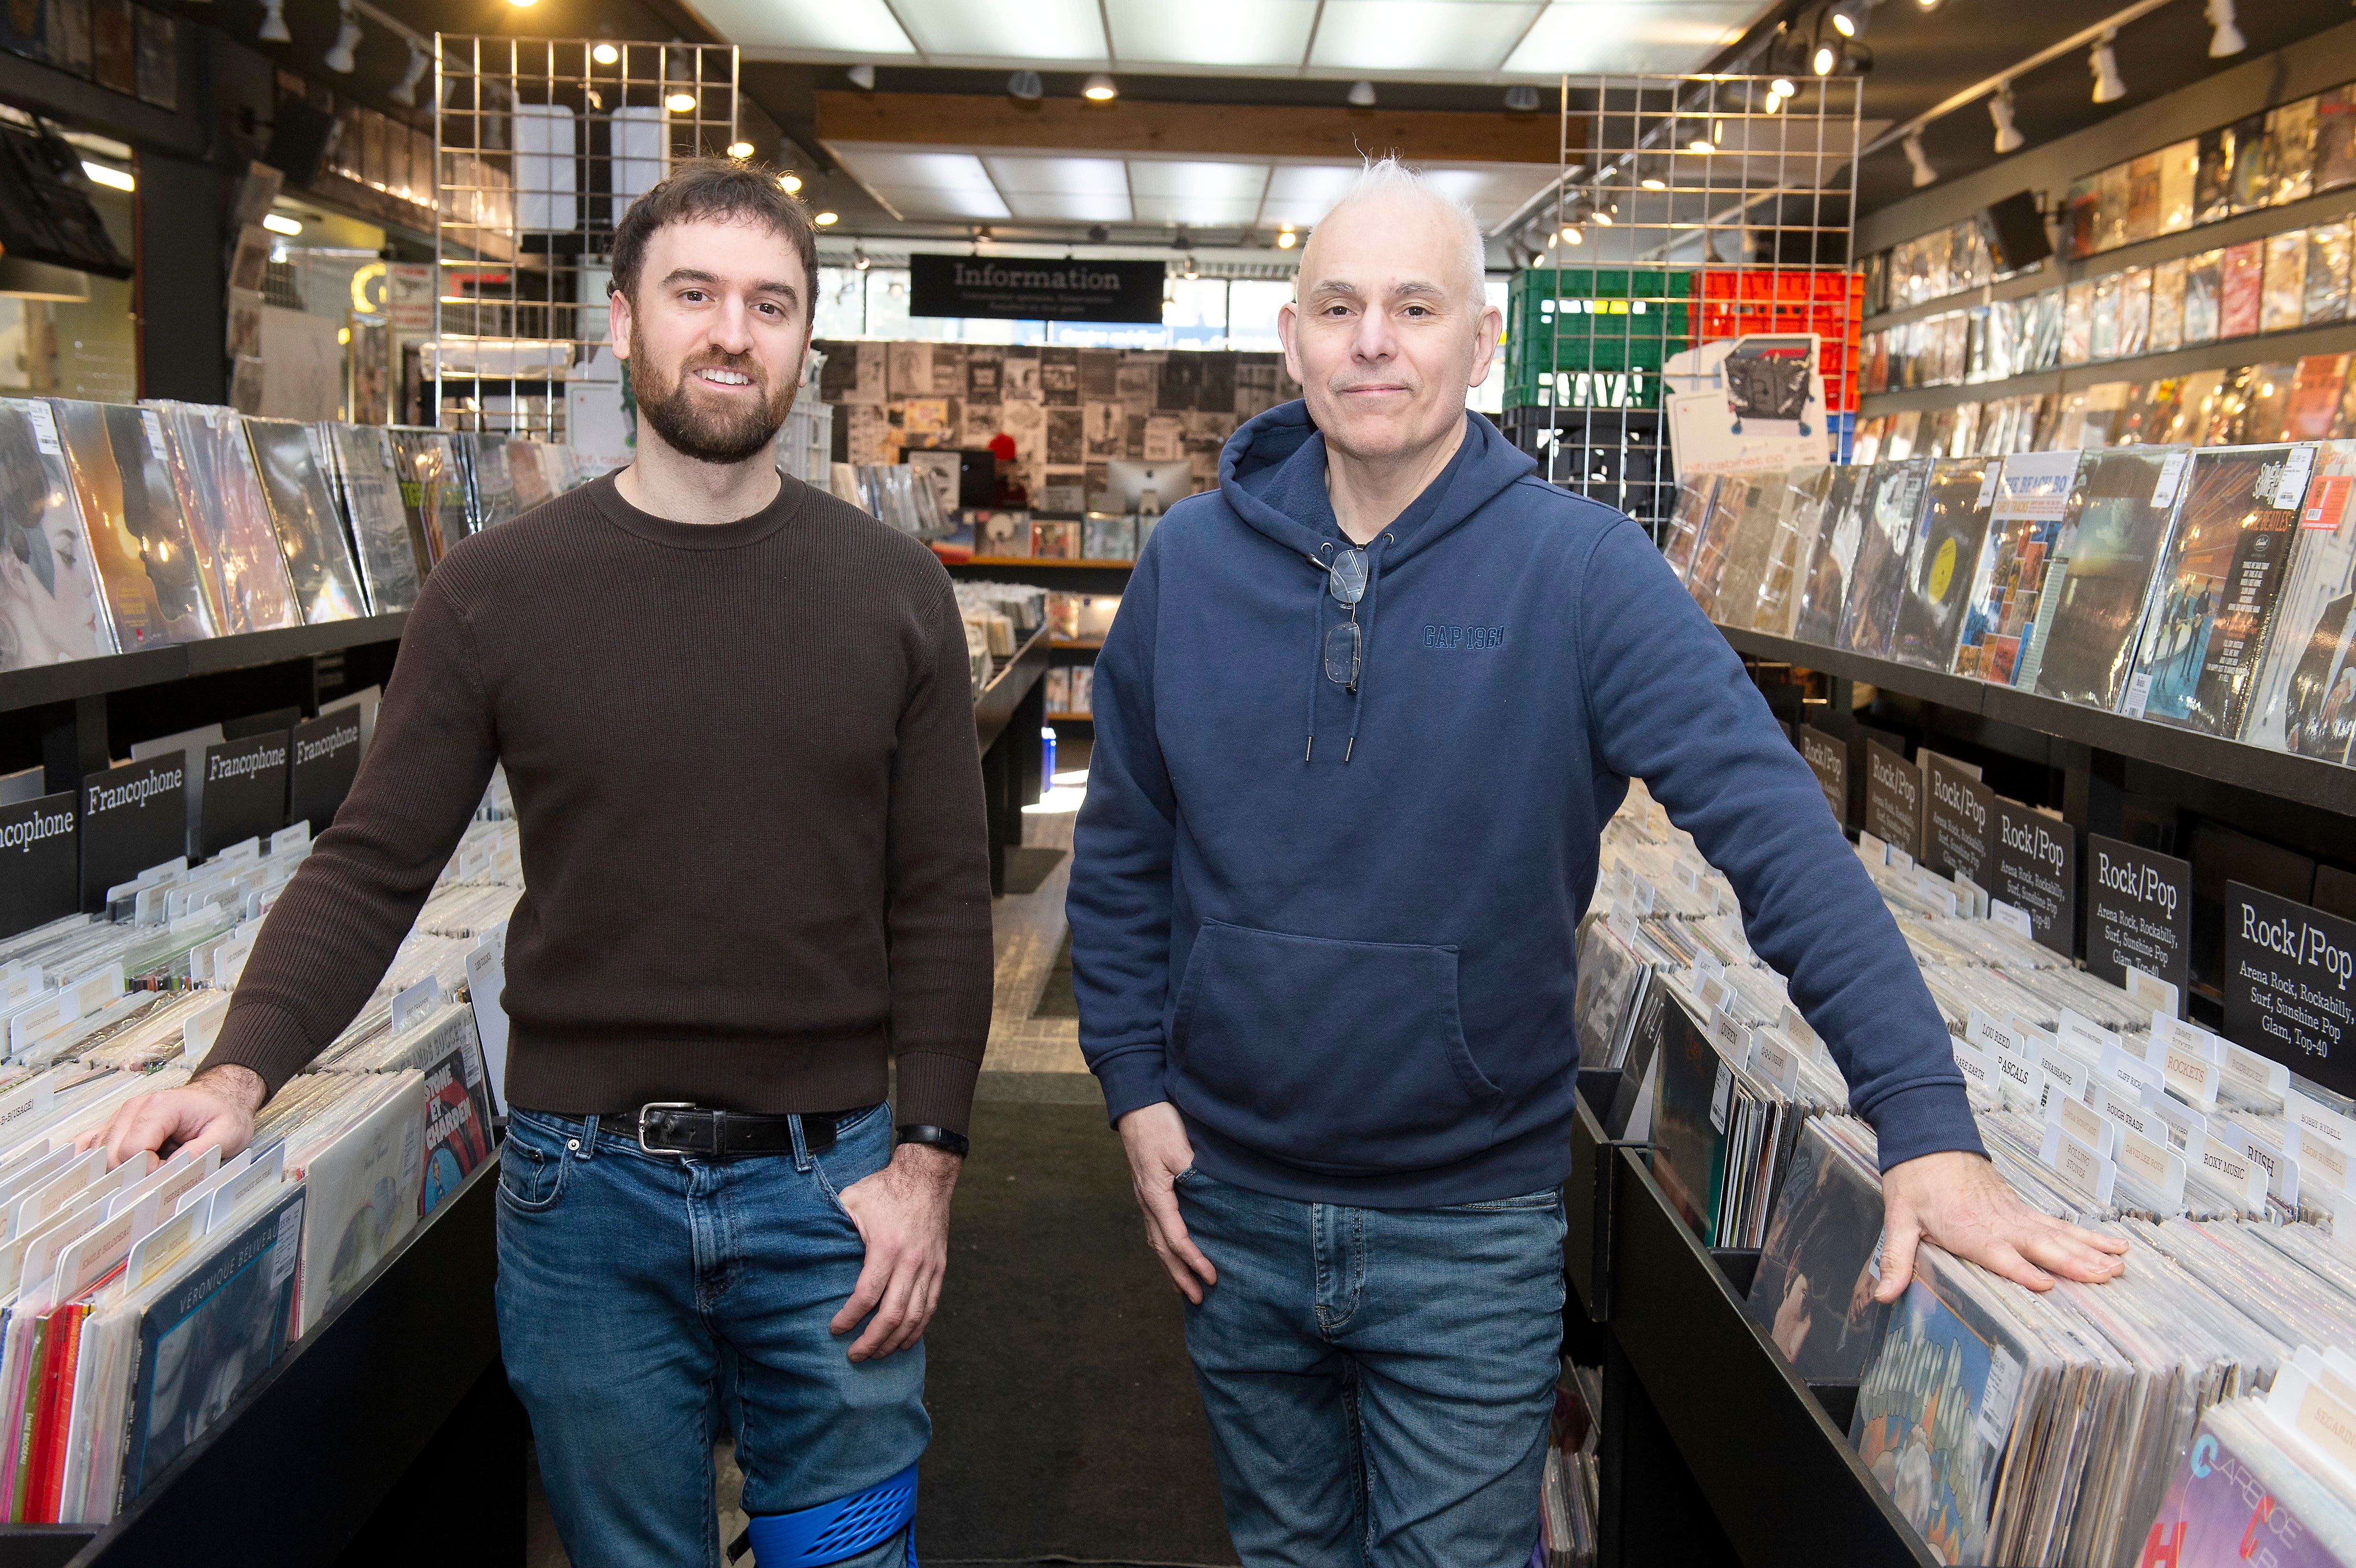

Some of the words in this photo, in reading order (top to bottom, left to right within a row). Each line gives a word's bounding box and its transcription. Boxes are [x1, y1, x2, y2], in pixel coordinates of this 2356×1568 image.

[953, 262, 1121, 290] Information
[1423, 625, 1462, 649] GAP
[296, 726, 359, 765] Francophone
[209, 745, 286, 781] Francophone
[87, 769, 183, 816] Francophone
[1873, 754, 1916, 811] Rock/Pop
[1934, 770, 1985, 834] Rock/Pop
[2001, 815, 2064, 876] Rock/Pop
[2000, 860, 2018, 878] Arena
[2034, 873, 2065, 902] Rockabilly,
[2098, 852, 2177, 920] Rock/Pop
[2021, 885, 2046, 909] Sunshine
[2046, 897, 2058, 919] Pop
[2096, 902, 2118, 923] Arena
[2119, 910, 2138, 933] Rock,
[2139, 917, 2178, 949] Rockabilly,
[2105, 925, 2122, 947] Surf,
[2123, 932, 2153, 957] Sunshine
[2155, 944, 2168, 968] Pop
[2241, 903, 2354, 991] Rock/Pop
[2239, 960, 2269, 985] Arena
[2270, 970, 2297, 1000] Rock,
[2300, 983, 2355, 1025] Rockabilly,
[2251, 987, 2274, 1013] Surf,
[2276, 997, 2319, 1031] Sunshine
[2321, 1016, 2341, 1045] Pop
[1721, 1022, 1737, 1046] QUEEN
[1982, 1023, 1993, 1040] LOU
[1993, 1031, 2010, 1049] REED
[2262, 1014, 2291, 1045] Glam,
[2294, 1028, 2328, 1058] Top-40
[424, 1063, 453, 1102] STONE
[1955, 1055, 1967, 1071] RARE
[1968, 1062, 1985, 1081] EARTH
[2041, 1057, 2072, 1086] RENAISSANCE
[2117, 1069, 2130, 1084] CLIFF
[2167, 1056, 2204, 1083] ROCKETS
[2231, 1059, 2263, 1083] RODRIGUEZ
[426, 1097, 472, 1150] CHARDEN
[429, 1095, 442, 1123] ET
[2064, 1108, 2076, 1122] LINDA
[2076, 1116, 2097, 1136] RONSTADT
[2107, 1102, 2125, 1122] ROUGH
[2125, 1113, 2144, 1133] TRADE
[2301, 1113, 2319, 1129] BOBBY
[2319, 1122, 2341, 1141] RYDELL
[2066, 1159, 2086, 1179] STONES
[2067, 1144, 2090, 1166] ROLLING
[2126, 1144, 2140, 1158] DAVID
[2140, 1152, 2150, 1165] LEE
[2150, 1158, 2164, 1173] ROTH
[2203, 1153, 2223, 1170] ROXY
[2223, 1161, 2245, 1180] MUSIC
[2247, 1145, 2275, 1177] RUSH
[2302, 1143, 2317, 1159] LEON
[2318, 1152, 2343, 1175] RUSSELL
[238, 1224, 278, 1267] BÉLIVEAU
